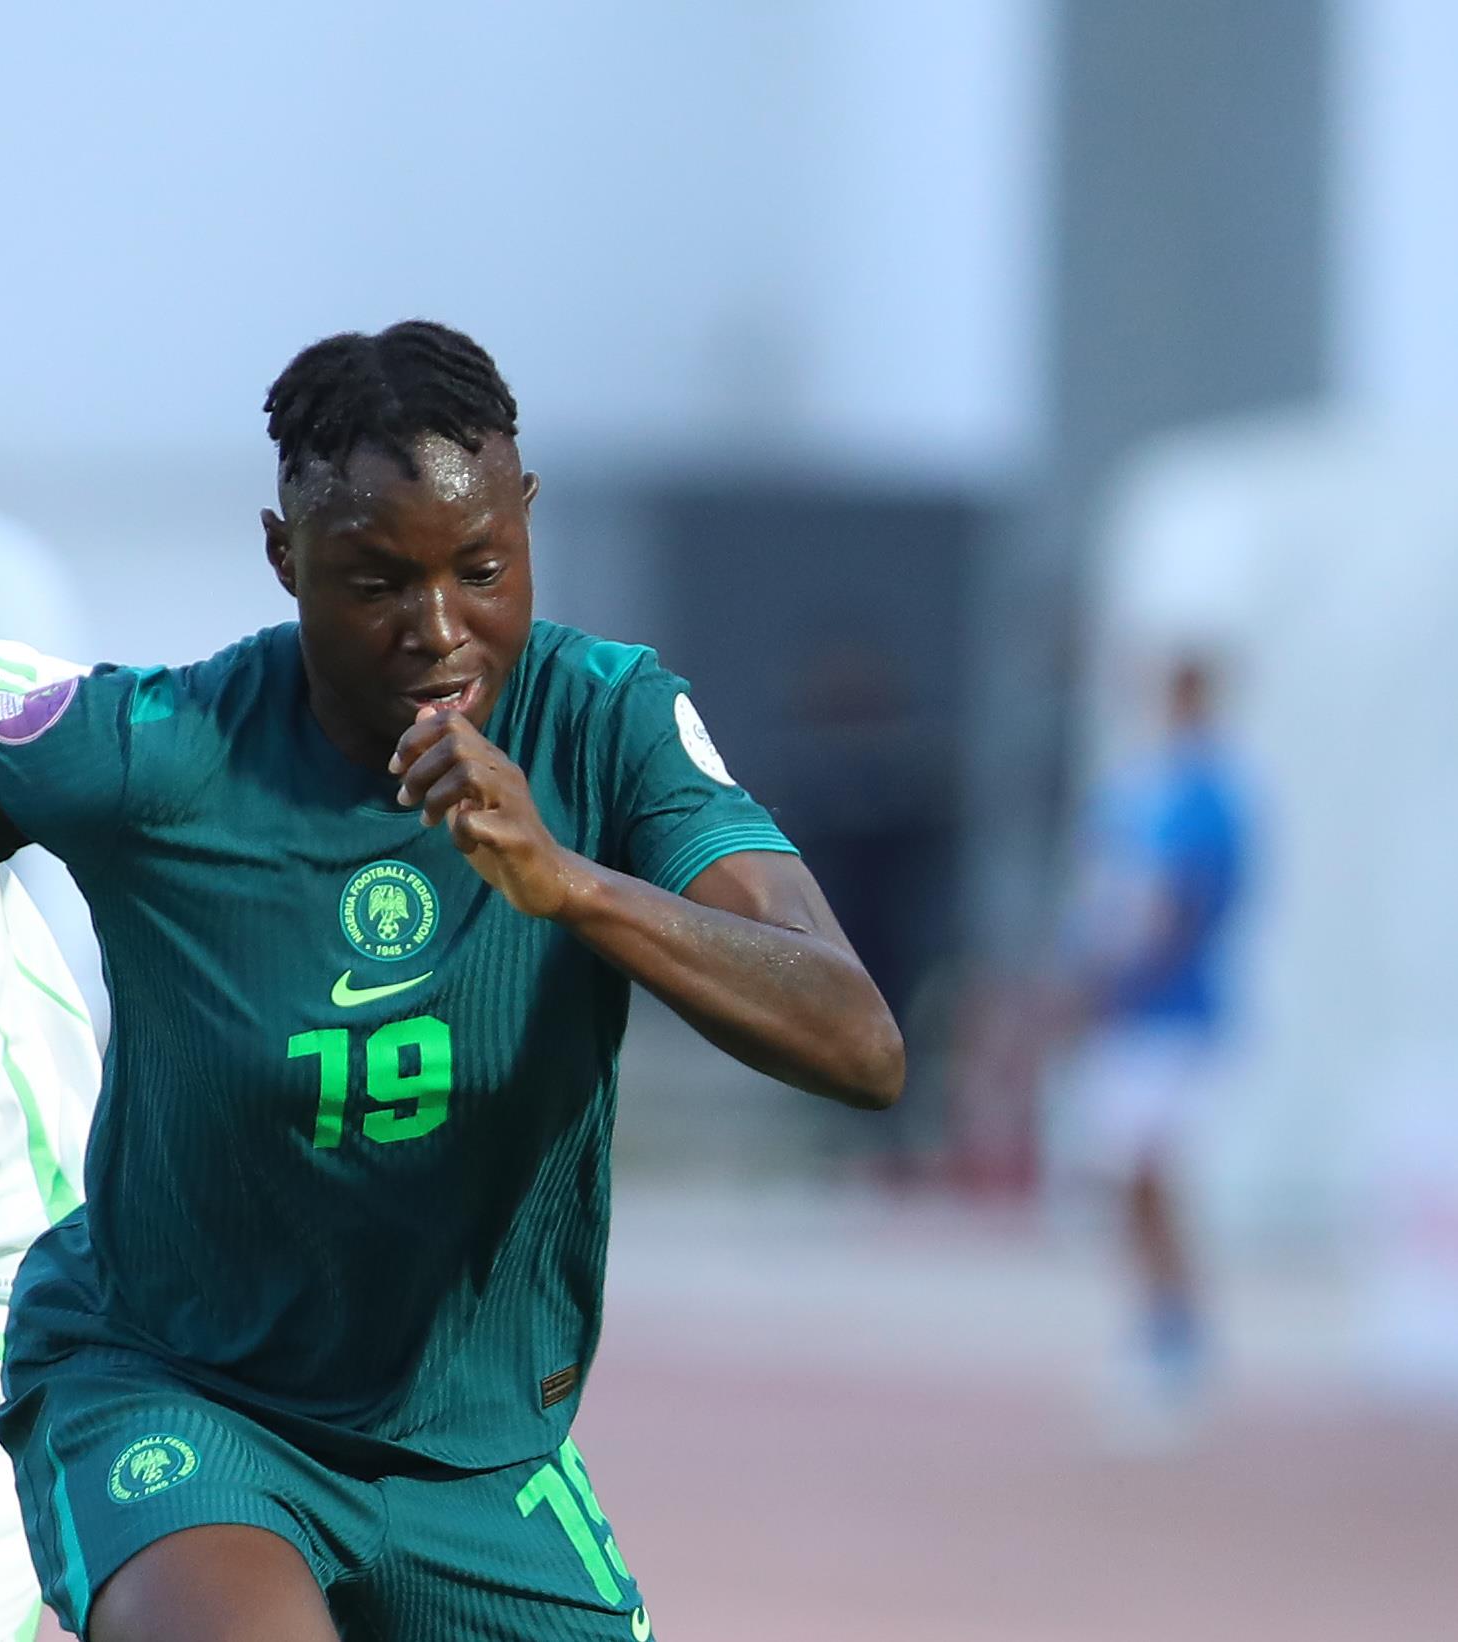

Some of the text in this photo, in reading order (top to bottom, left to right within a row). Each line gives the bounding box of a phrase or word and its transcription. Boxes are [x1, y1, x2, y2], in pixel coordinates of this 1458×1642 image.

[344, 866, 434, 943] NIGERIA FOOTBALL FEDERATION
[376, 943, 402, 956] 1945
[287, 1015, 452, 1149] 19
